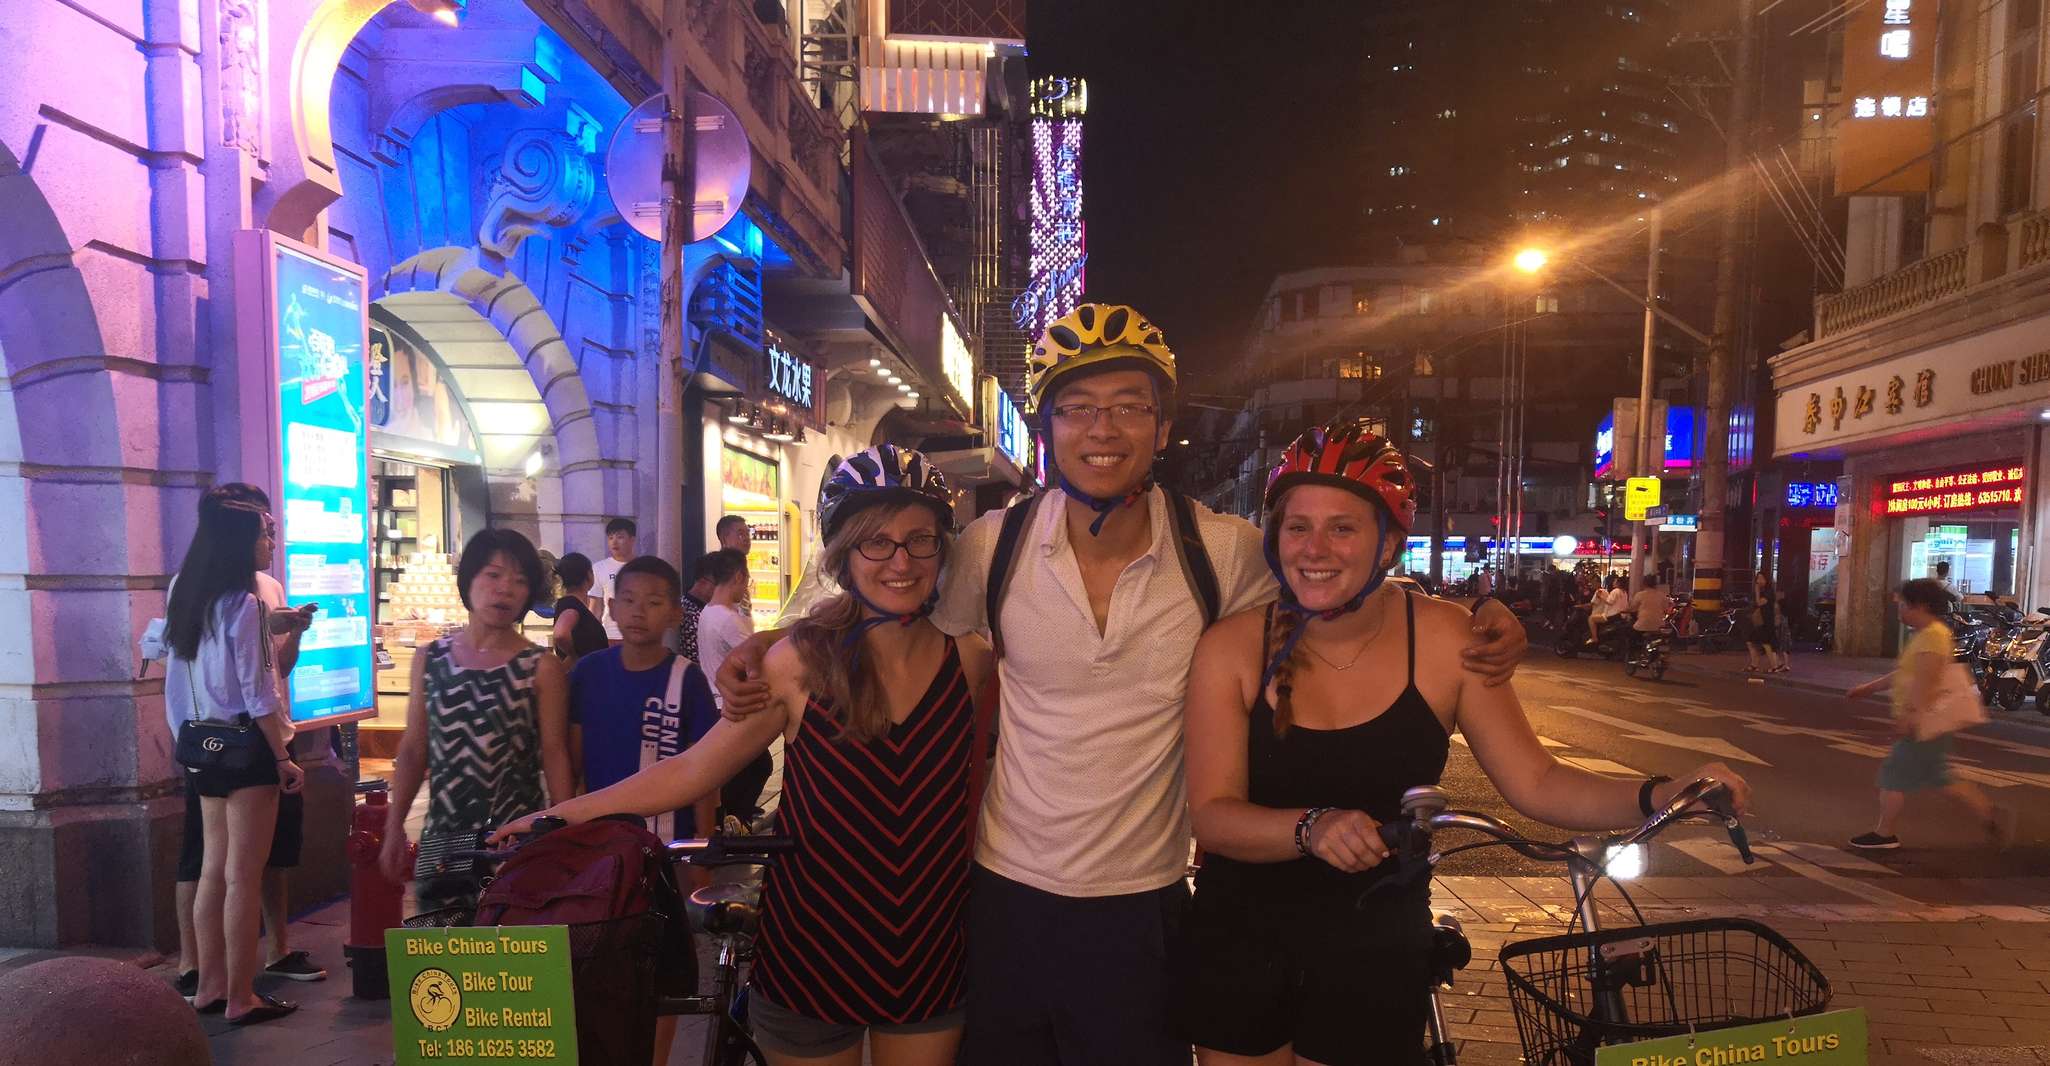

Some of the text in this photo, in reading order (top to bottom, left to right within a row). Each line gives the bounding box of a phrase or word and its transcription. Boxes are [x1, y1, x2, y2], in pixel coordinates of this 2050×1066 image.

[1855, 96, 1927, 117] 连锁店
[769, 344, 812, 408] 文龙水果
[1971, 359, 2016, 395] CHUN
[1788, 483, 1837, 507] 驿站
[406, 936, 548, 955] Bike China Tours
[462, 971, 533, 992] Bike Tour
[465, 1007, 552, 1028] Bike Rental
[418, 1039, 555, 1058] Tel: 186 1625 3582
[1695, 1043, 1765, 1066] China
[1772, 1031, 1840, 1057] Tours
